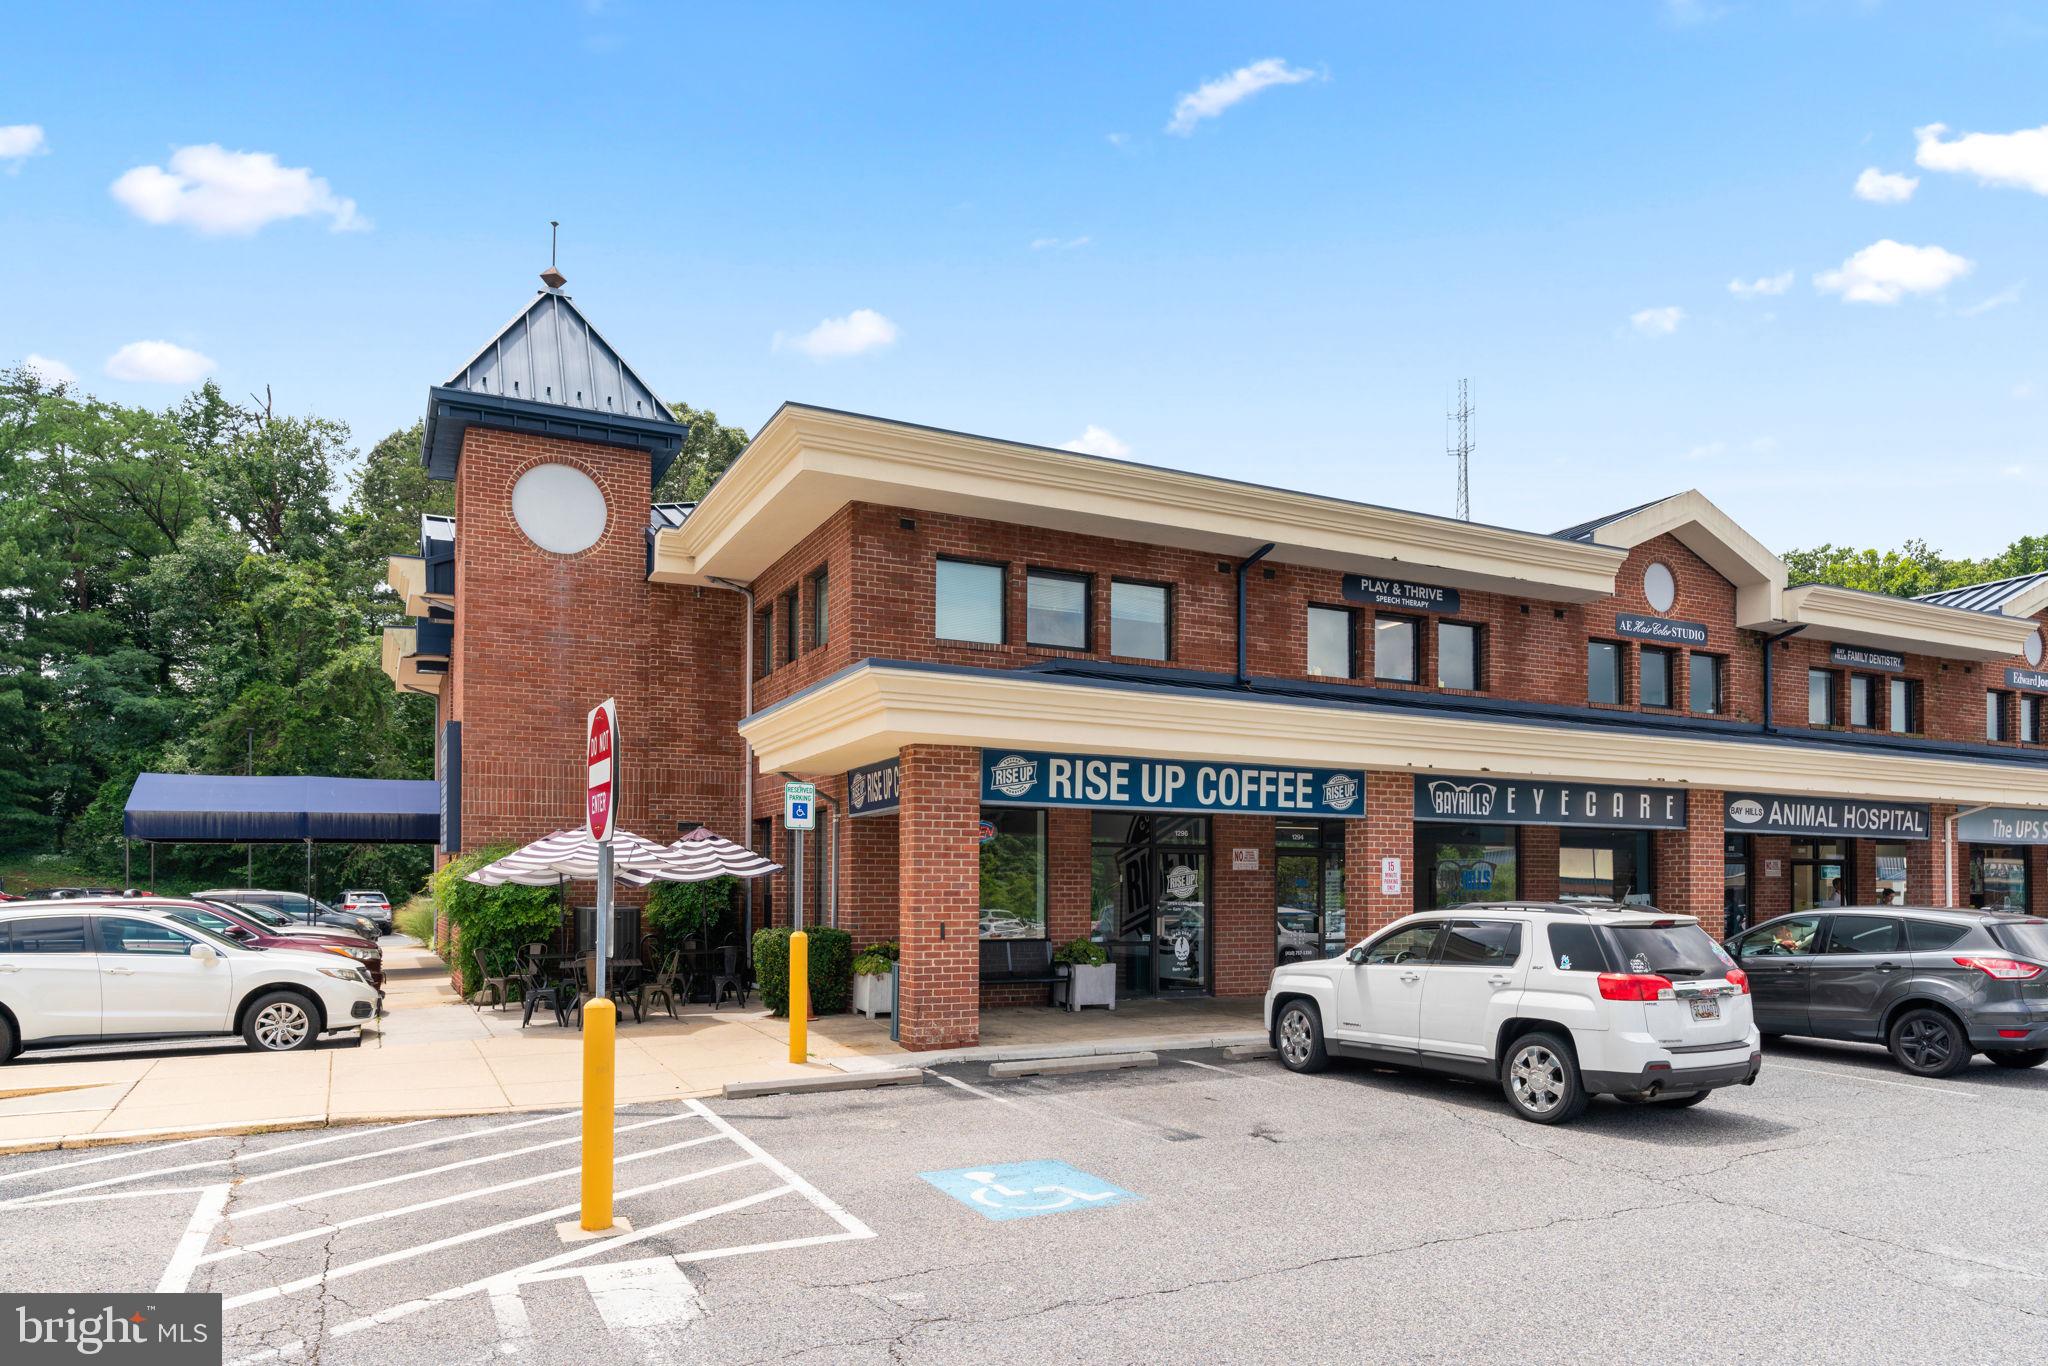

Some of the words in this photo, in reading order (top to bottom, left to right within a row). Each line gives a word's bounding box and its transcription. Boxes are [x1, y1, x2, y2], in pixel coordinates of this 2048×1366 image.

[1361, 579, 1389, 594] PLAY
[1392, 583, 1401, 595] &
[1404, 585, 1443, 601] THRIVE
[1376, 595, 1400, 605] SPEECH
[1402, 598, 1429, 608] THERAPY
[1620, 620, 1632, 631] AE
[1633, 620, 1652, 634] Hair
[1652, 622, 1671, 636] Color
[1672, 626, 1705, 641] STUDIO
[1847, 650, 1868, 663] FAMILY
[1869, 653, 1902, 667] DENTISTRY
[2013, 671, 2037, 686] Edward
[590, 736, 598, 757] DO
[599, 730, 609, 753] NOT
[995, 767, 1019, 785] RISE
[1020, 766, 1034, 781] UP
[1049, 758, 1129, 801] RISE
[1141, 763, 1186, 803] UP
[1196, 766, 1313, 809] COFFEE
[787, 786, 812, 794] RESERVED
[867, 770, 882, 803] RISE
[883, 768, 892, 799] UP
[1326, 785, 1344, 800] RISE
[1344, 783, 1355, 797] UP
[591, 791, 607, 815] ENTER
[1507, 787, 1673, 819] EYECARE
[1730, 806, 1742, 815] BAY
[1745, 807, 1762, 816] HILLS
[1768, 801, 1838, 828] ANIMAL
[1844, 805, 1923, 832] HOSPITAL
[1993, 819, 2012, 838] The
[2016, 820, 2039, 839] UPS
[1234, 850, 1244, 861] NO
[1388, 861, 1395, 871] 15
[1170, 876, 1186, 889] RISE
[1186, 874, 1195, 886] UP
